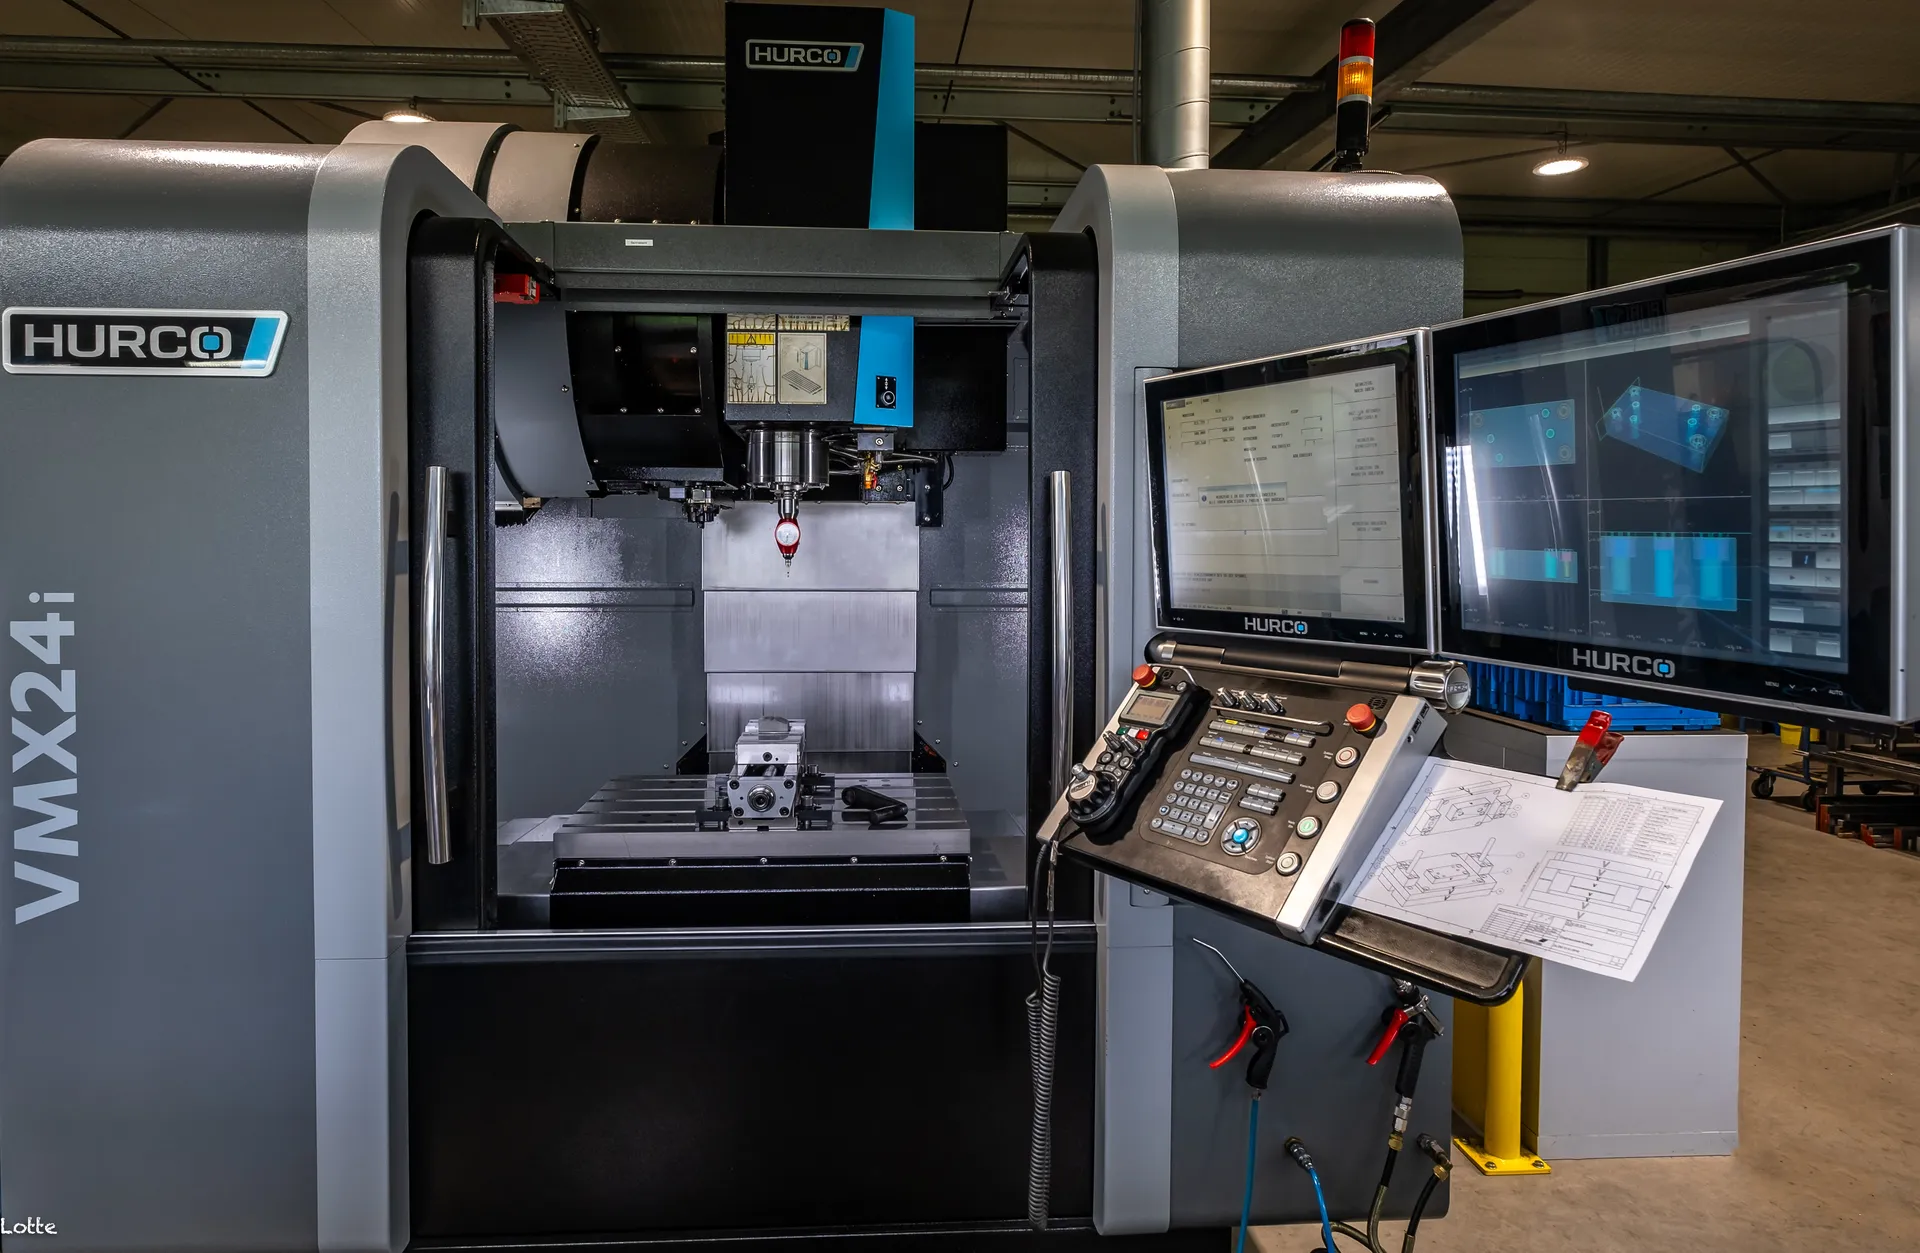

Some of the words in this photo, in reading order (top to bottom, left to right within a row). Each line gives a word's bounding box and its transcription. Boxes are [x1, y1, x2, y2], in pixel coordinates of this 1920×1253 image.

[755, 46, 841, 64] HURCO
[24, 324, 231, 359] HURCO
[1244, 617, 1308, 635] HURCO
[1572, 647, 1676, 679] HURCO
[10, 591, 80, 925] VMX24i
